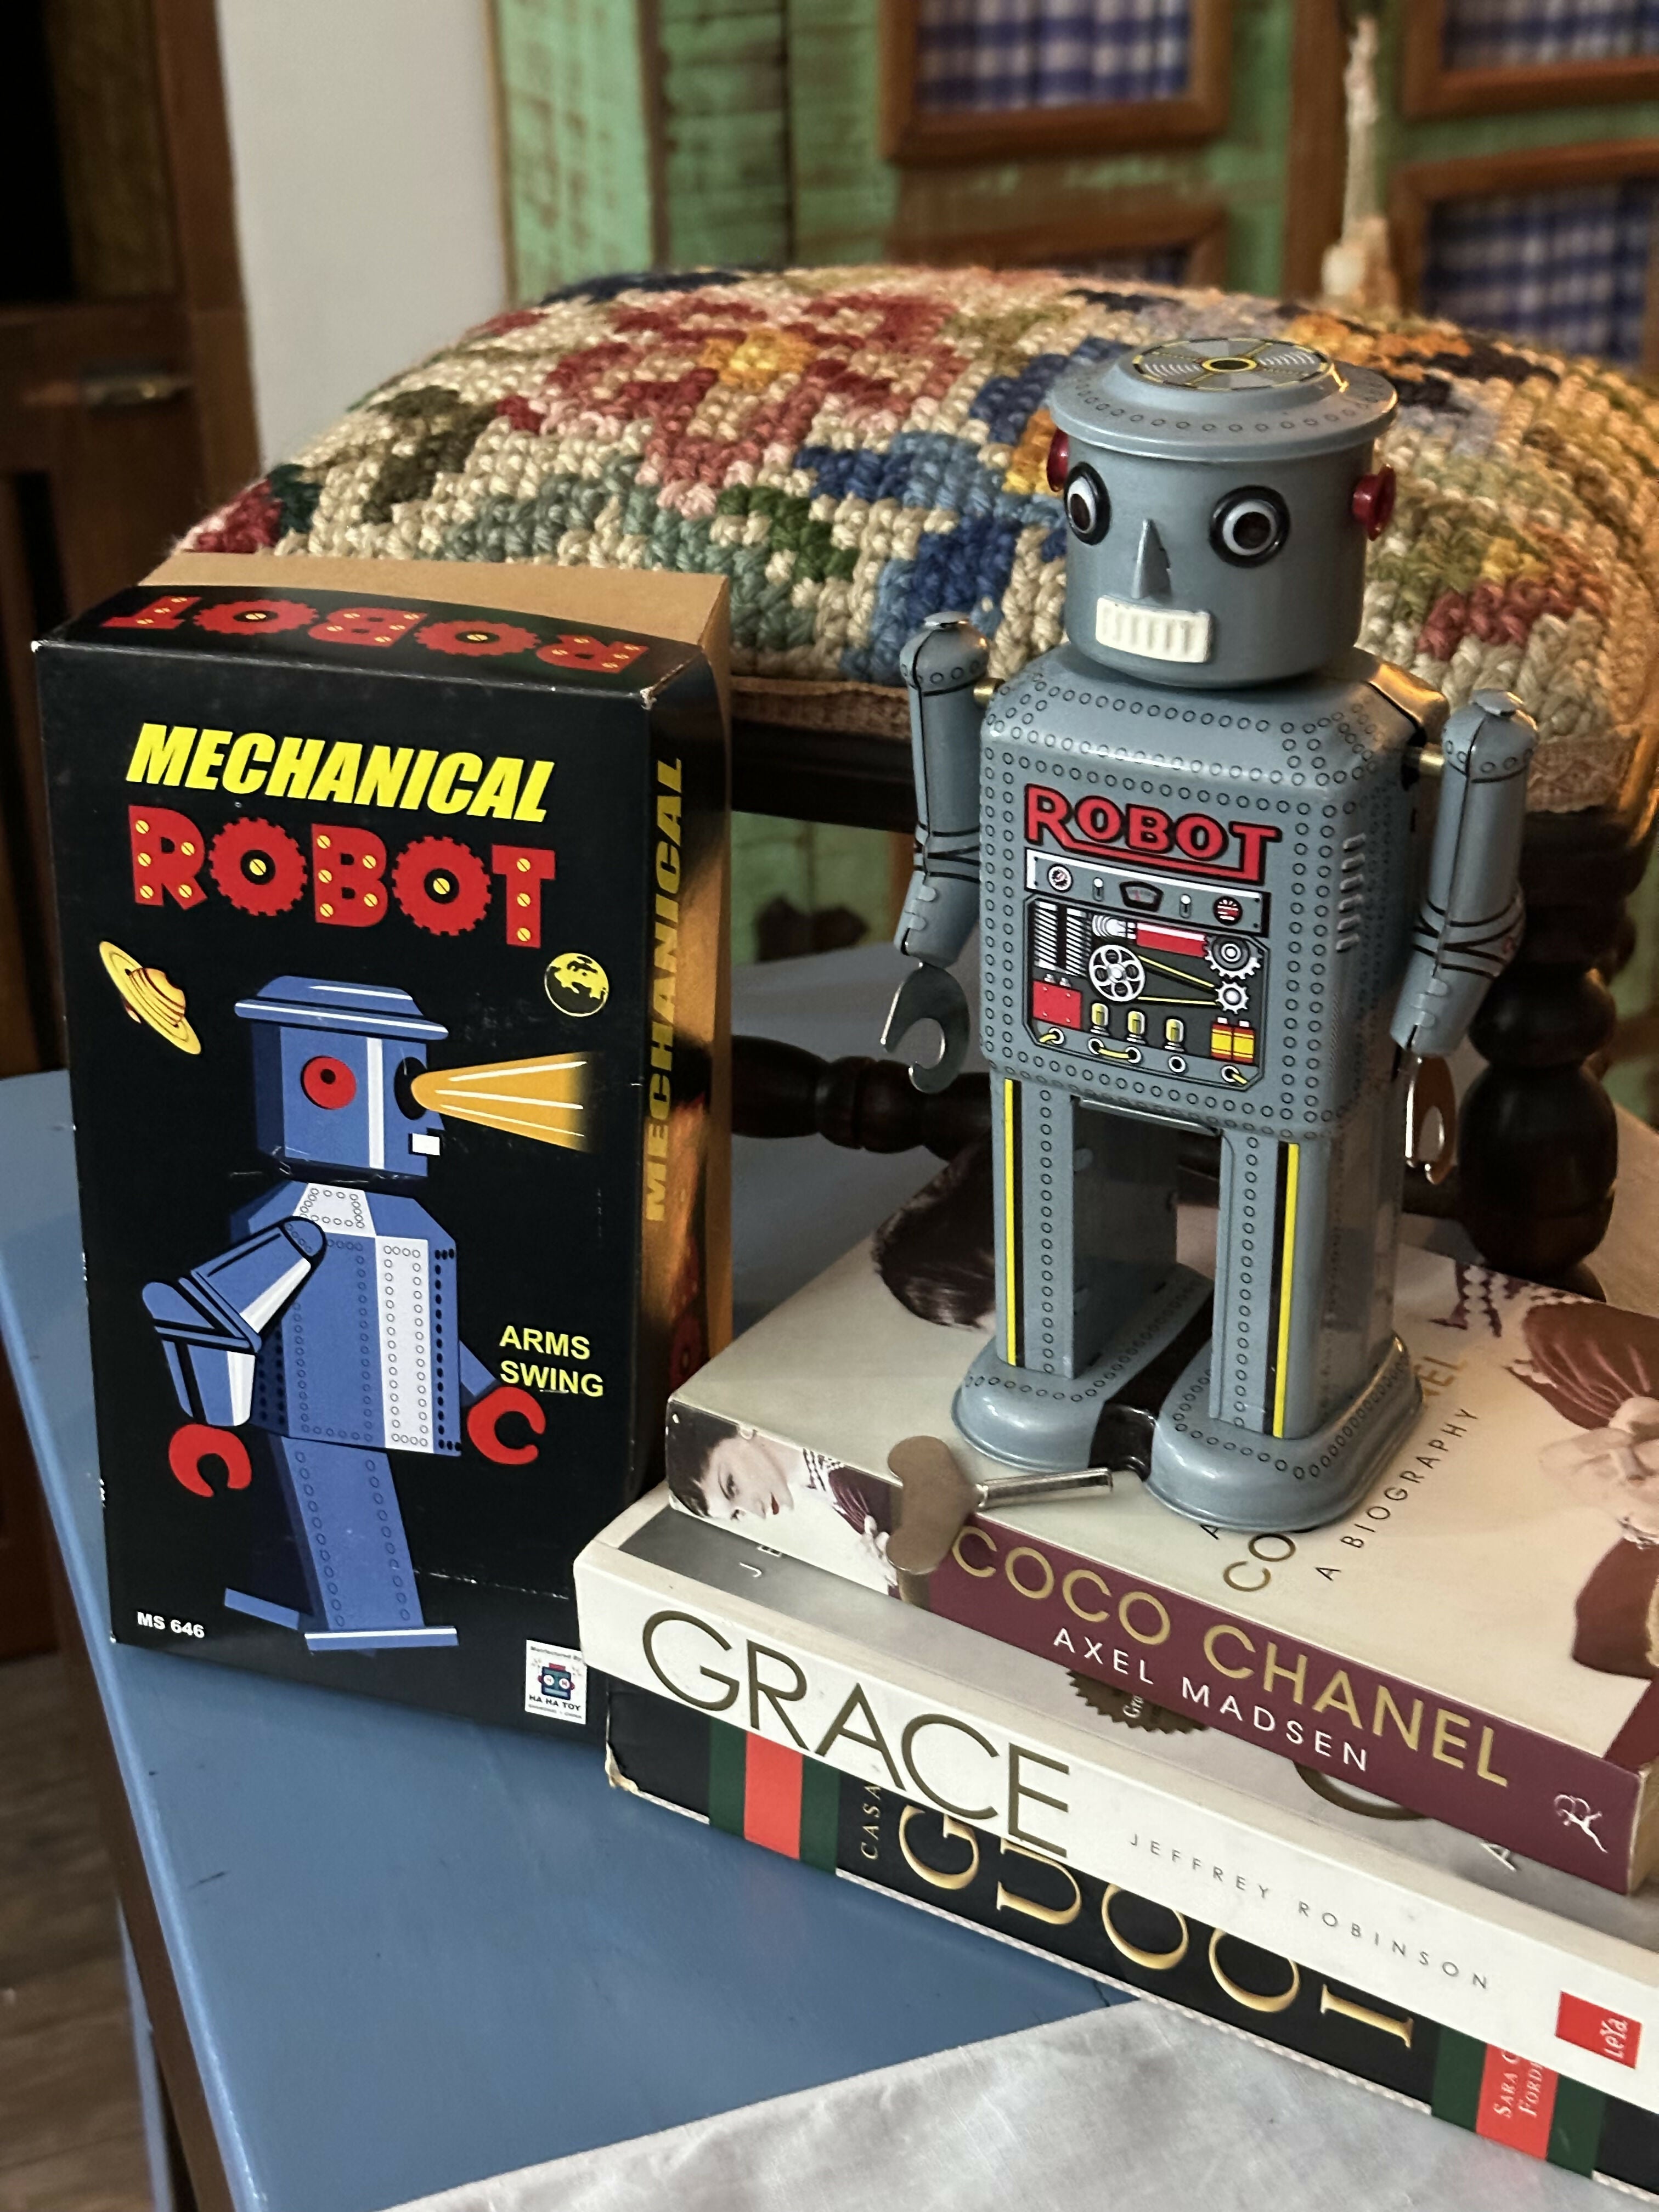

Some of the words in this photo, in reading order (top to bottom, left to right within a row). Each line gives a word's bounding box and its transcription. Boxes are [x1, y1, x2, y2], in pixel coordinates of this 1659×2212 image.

[100, 596, 649, 674] ROBOT
[126, 723, 555, 822] MECHANICAL
[1025, 783, 1282, 885] ROBOT
[128, 805, 555, 949] ROBOT
[646, 758, 682, 1222] MECHANICAL
[500, 1325, 590, 1360] ARMS
[500, 1361, 604, 1397] SWING
[1315, 1565, 1341, 1582] A
[1340, 1408, 1478, 1548] BIOGRAPHY
[137, 1612, 166, 1632] MS
[170, 1619, 205, 1639] 646
[952, 1526, 1171, 1645] COCO
[1204, 1624, 1508, 1788] CHANEL
[562, 1702, 581, 1711] TOY
[642, 1610, 1069, 1858] GRACE
[1053, 1628, 1154, 1684] AXEL
[1182, 1677, 1367, 1772] MADSEN
[861, 1786, 882, 1860] CASA
[898, 1805, 1414, 2049] GUCCI
[1131, 1833, 1271, 1899] JEFFREY
[1298, 1900, 1488, 1990] ROBINSON
